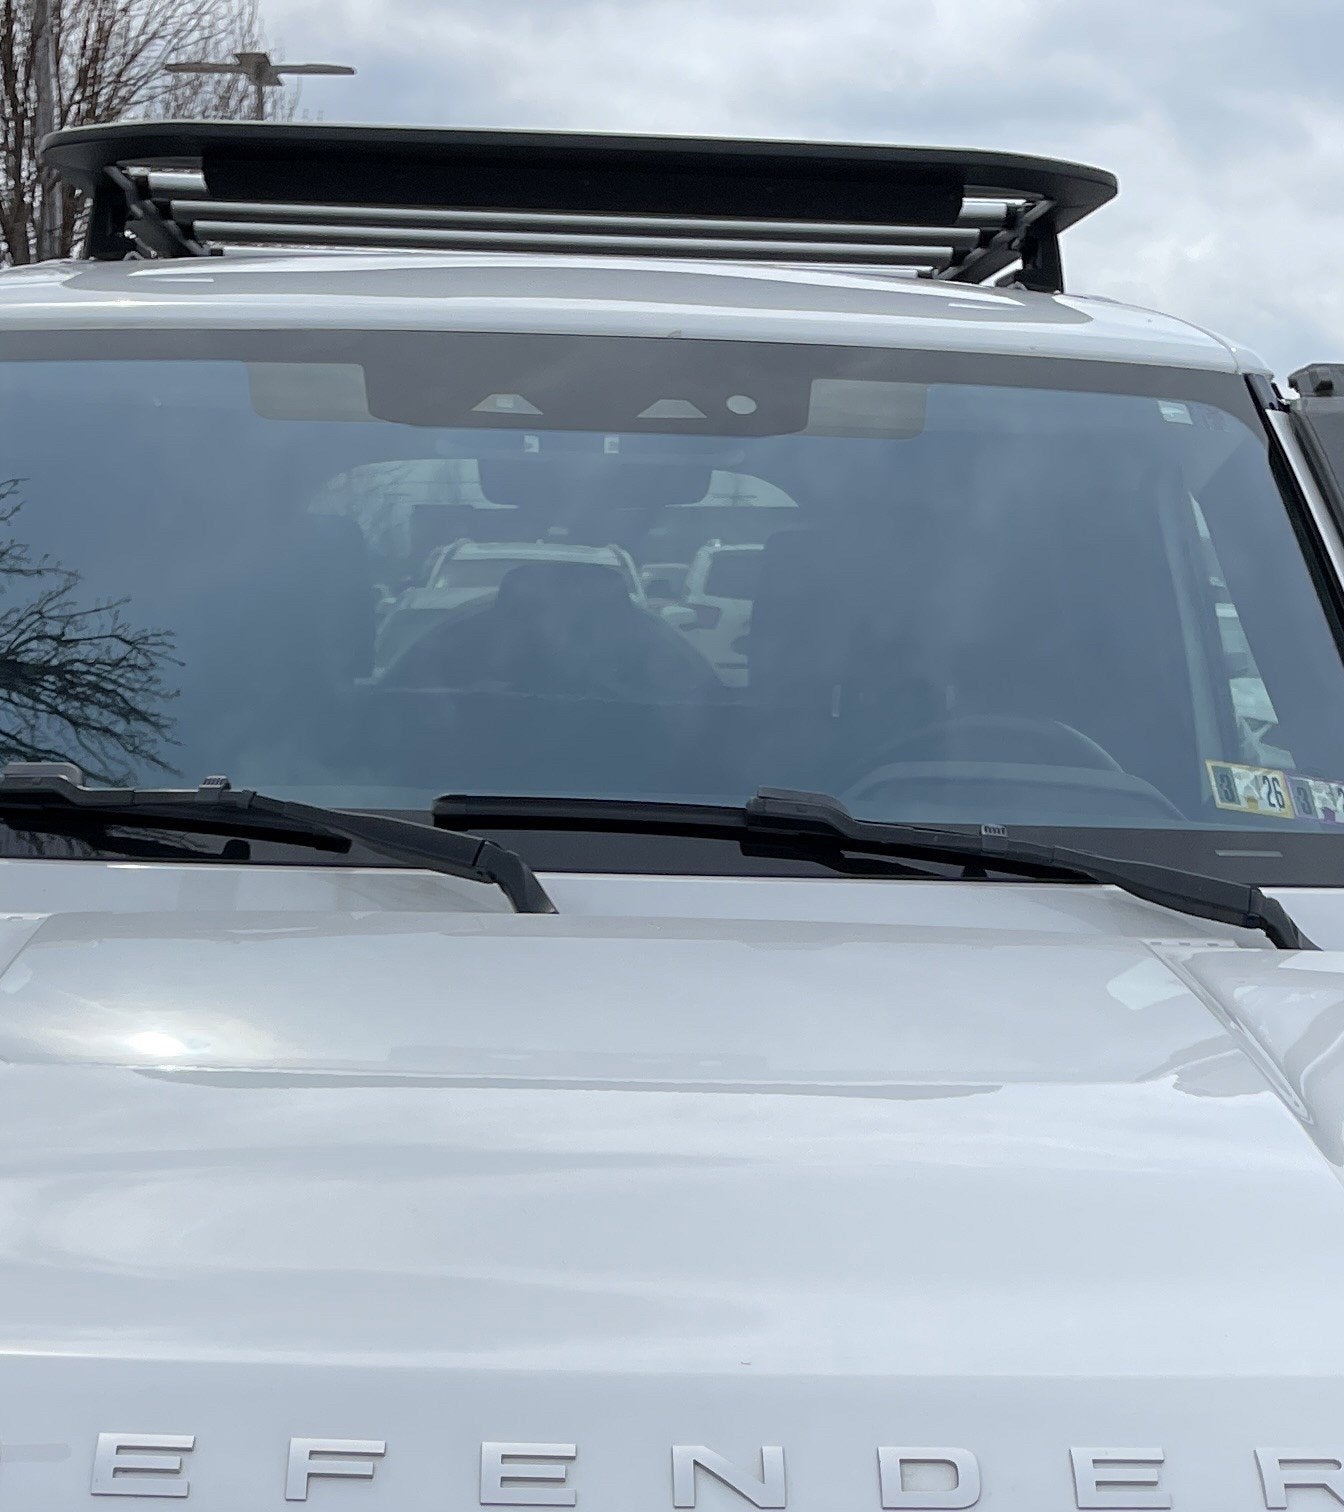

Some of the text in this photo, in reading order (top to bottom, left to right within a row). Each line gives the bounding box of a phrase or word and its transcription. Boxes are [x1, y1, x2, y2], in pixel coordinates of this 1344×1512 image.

[1216, 772, 1286, 808] 3 26
[1294, 785, 1313, 815] 3
